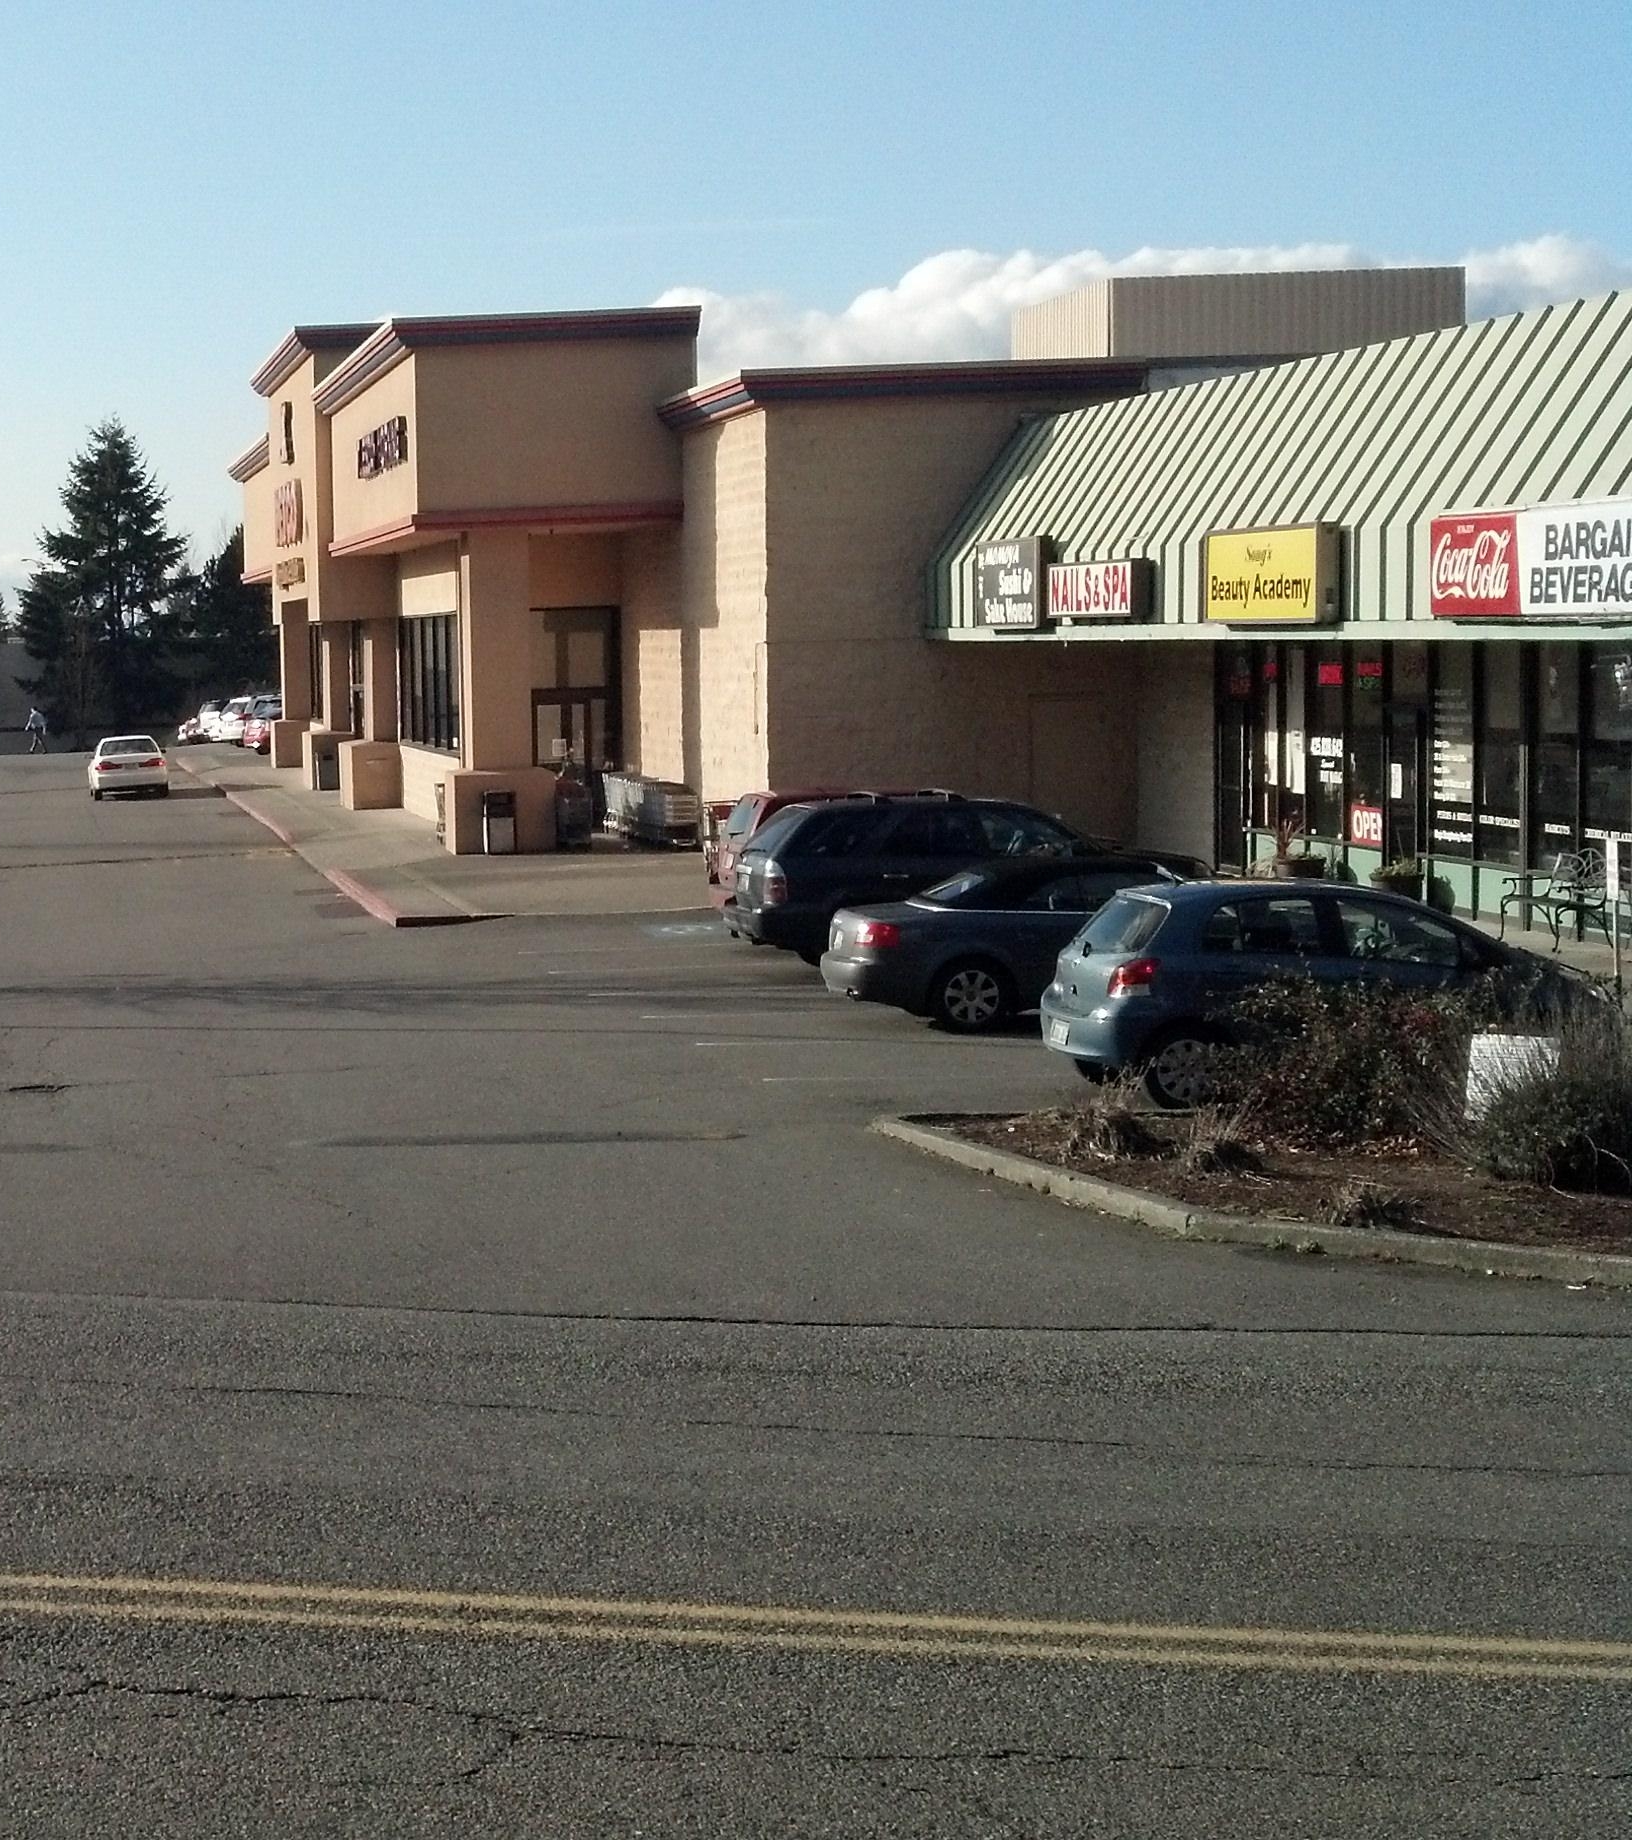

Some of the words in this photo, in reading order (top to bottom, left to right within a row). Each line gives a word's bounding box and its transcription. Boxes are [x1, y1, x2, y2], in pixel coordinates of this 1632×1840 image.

[1544, 518, 1632, 561] BARGAI
[998, 567, 1022, 596] Sushi
[1432, 529, 1511, 600] Coca-Cola
[1051, 566, 1092, 613] NAILS
[1103, 564, 1129, 612] SPA
[1211, 575, 1250, 609] Beauty
[1252, 572, 1312, 609] Academy
[984, 597, 1006, 624] Sake
[1005, 597, 1034, 623] House
